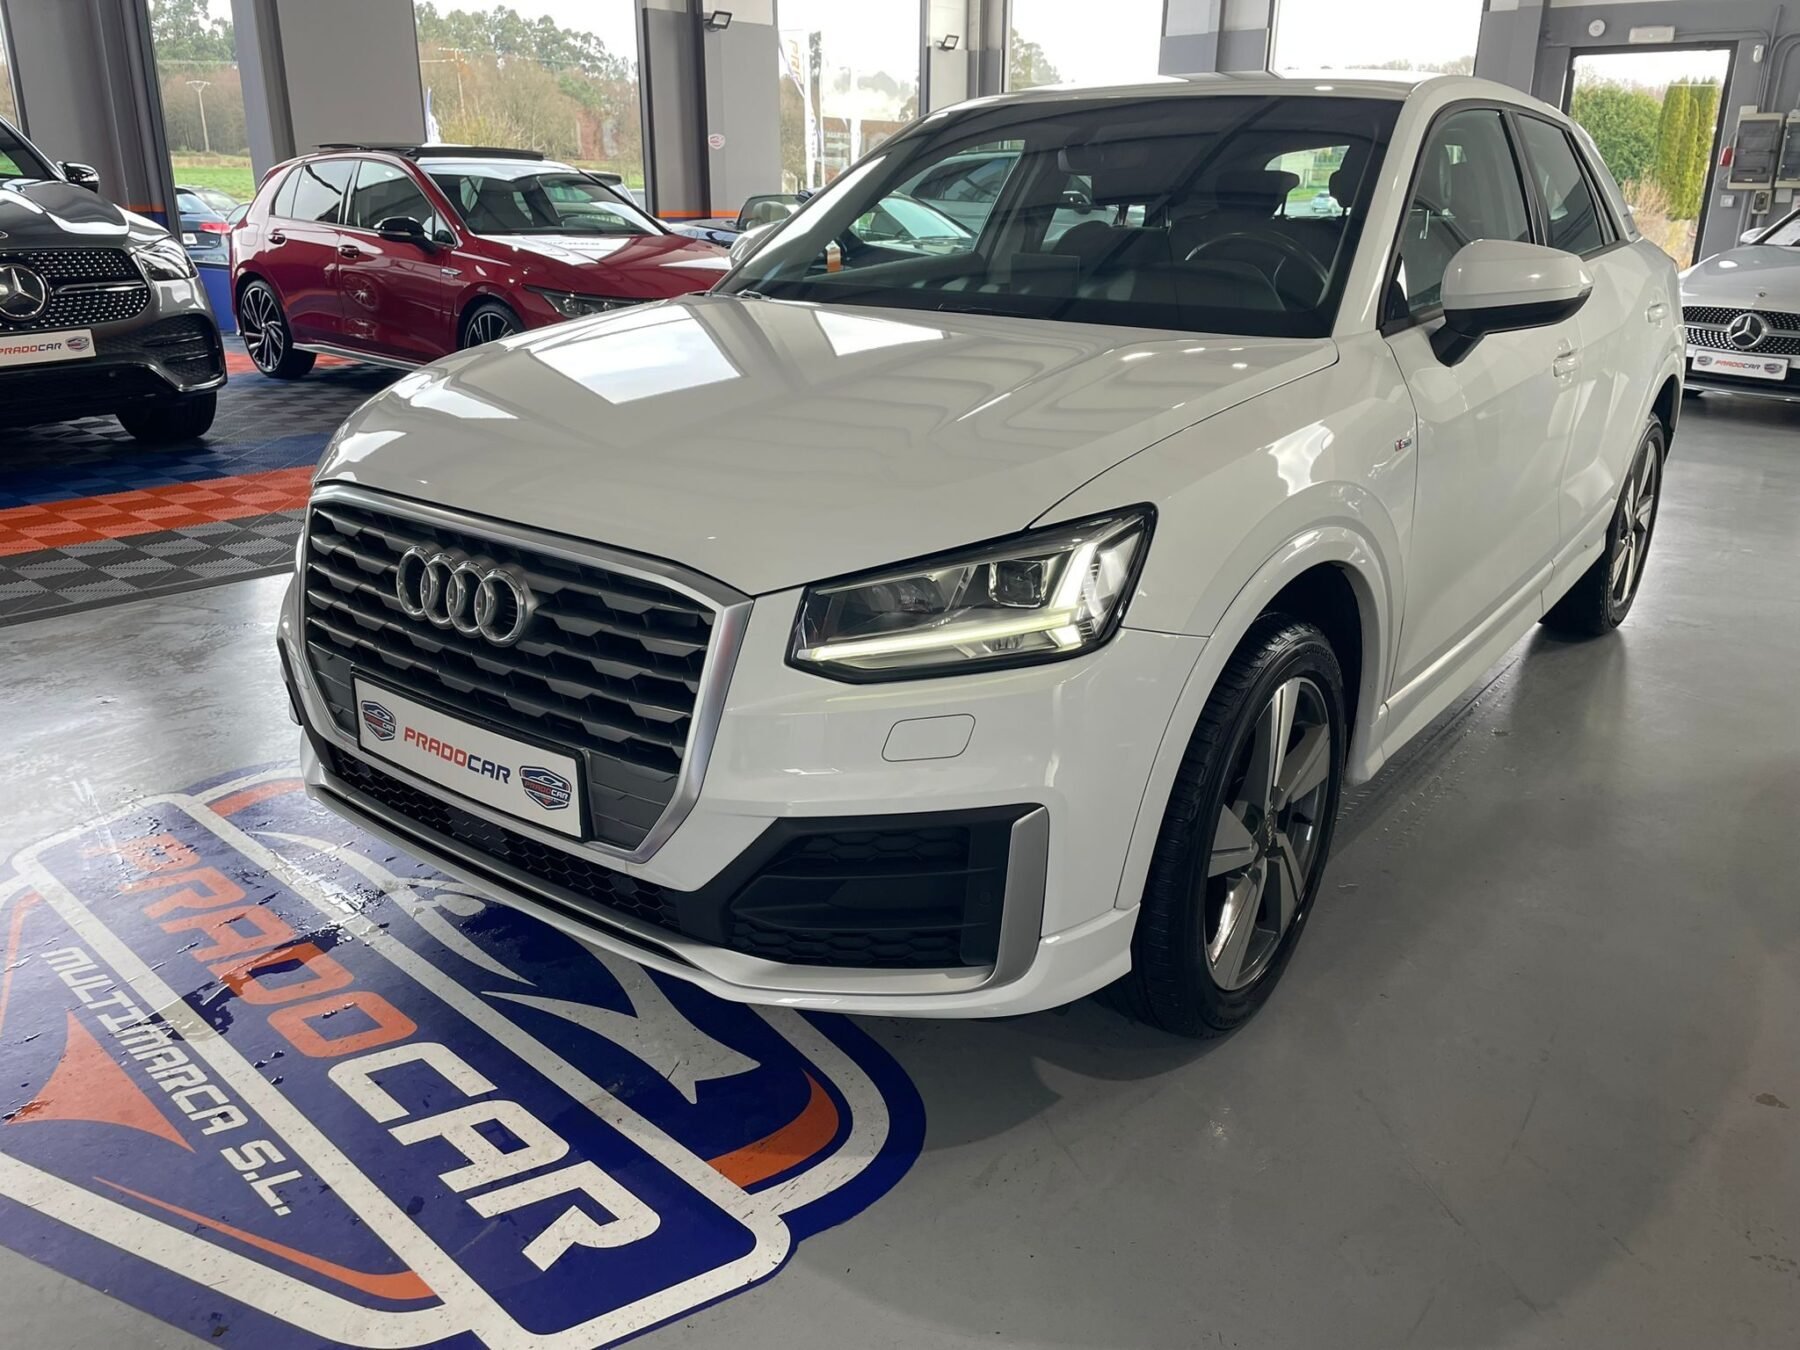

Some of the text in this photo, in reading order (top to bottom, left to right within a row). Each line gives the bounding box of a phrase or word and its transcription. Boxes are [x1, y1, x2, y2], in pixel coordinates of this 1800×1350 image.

[403, 726, 511, 784] PRADOCAR
[524, 780, 569, 801] PRADOCAR
[40, 946, 302, 1216] MULTIMARCA S.L.
[84, 834, 661, 1272] PRADOCAR
